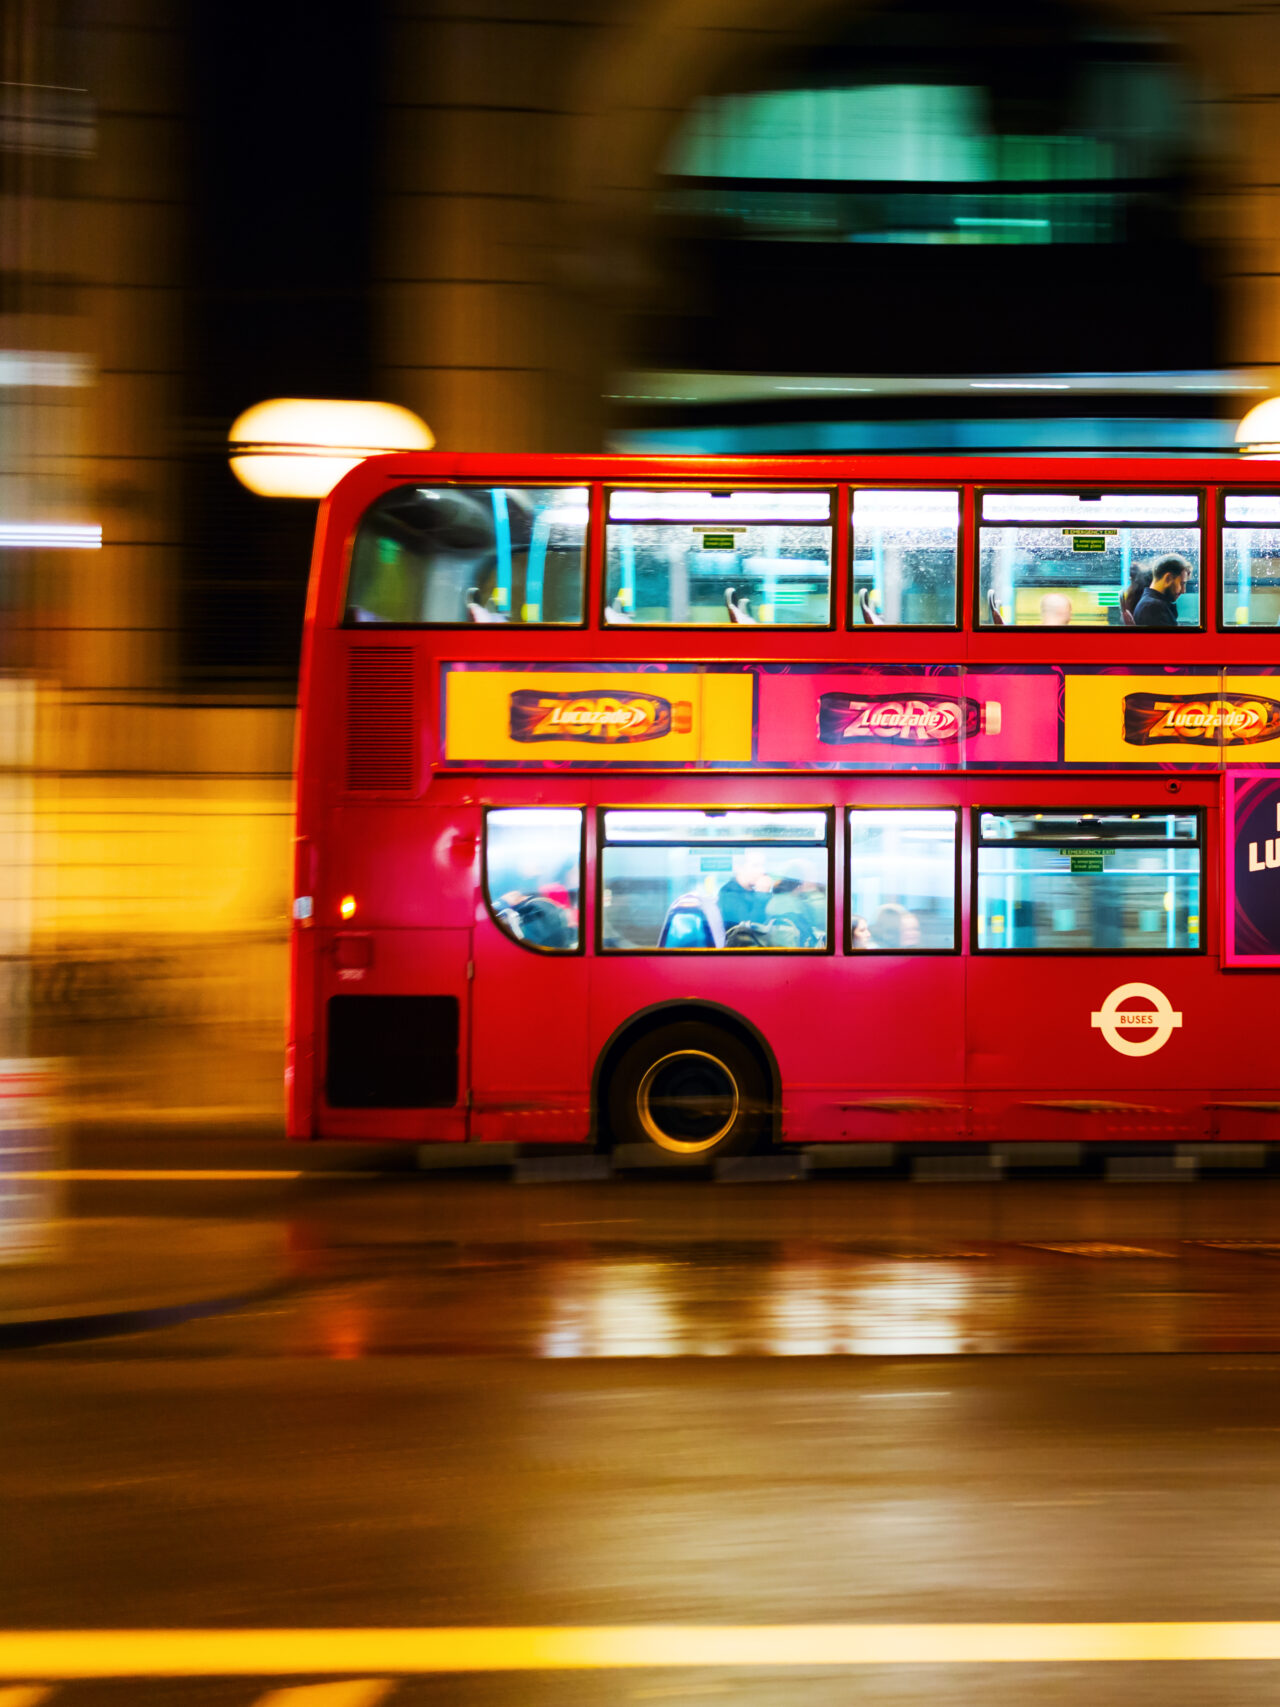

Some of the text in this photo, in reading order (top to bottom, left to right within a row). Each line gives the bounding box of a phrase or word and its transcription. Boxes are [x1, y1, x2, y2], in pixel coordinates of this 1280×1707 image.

[551, 708, 633, 724] Lucozade
[862, 710, 941, 726] Lucozade
[1166, 710, 1245, 726] Lucozade
[1120, 1015, 1153, 1024] BUSES
